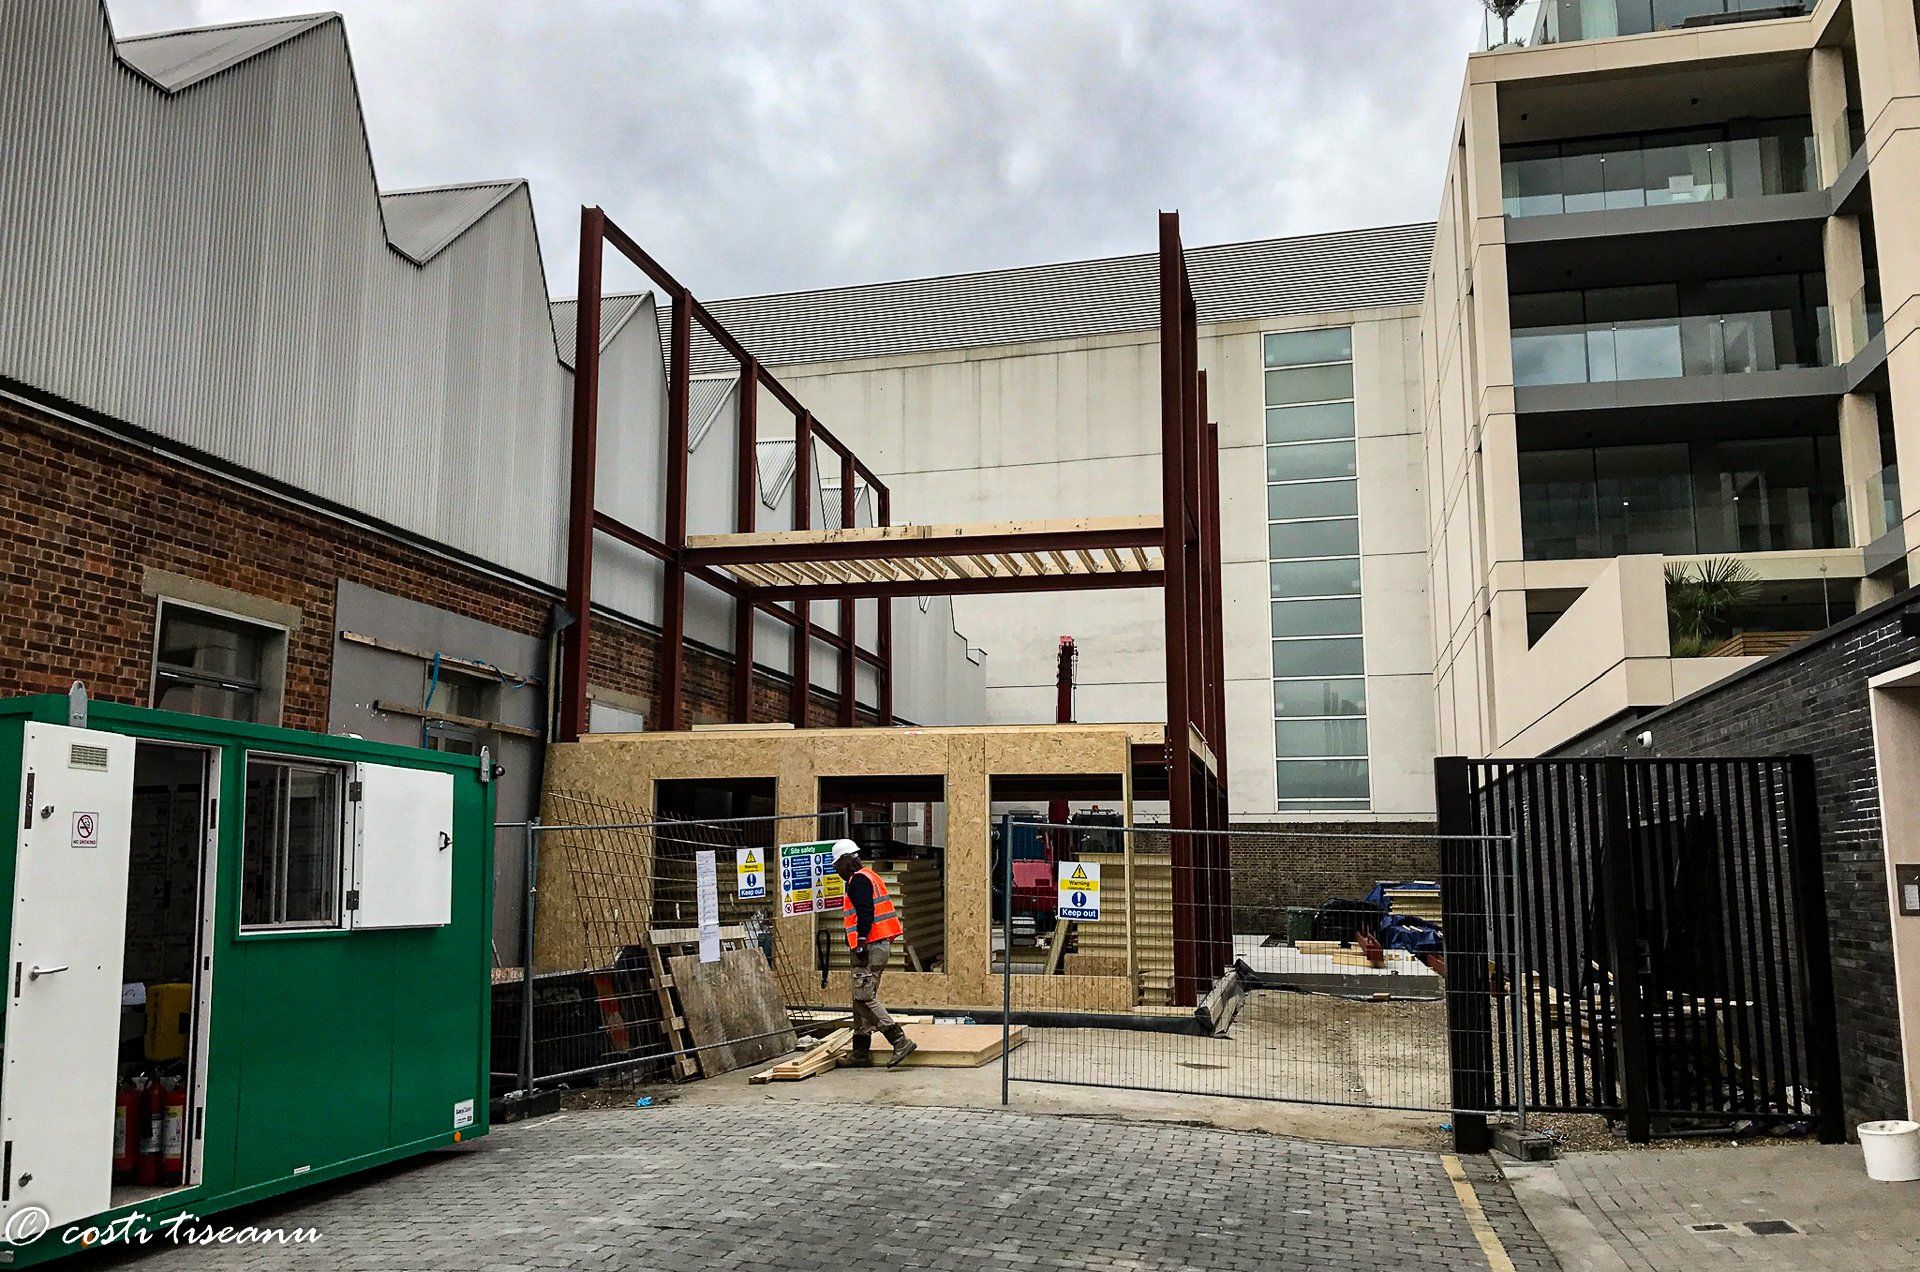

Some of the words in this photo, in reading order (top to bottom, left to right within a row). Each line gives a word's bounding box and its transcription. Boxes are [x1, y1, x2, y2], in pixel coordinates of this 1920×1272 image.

[790, 847, 801, 855] Site
[801, 846, 816, 854] safety
[1062, 908, 1082, 918] Keep
[1083, 909, 1096, 917] out
